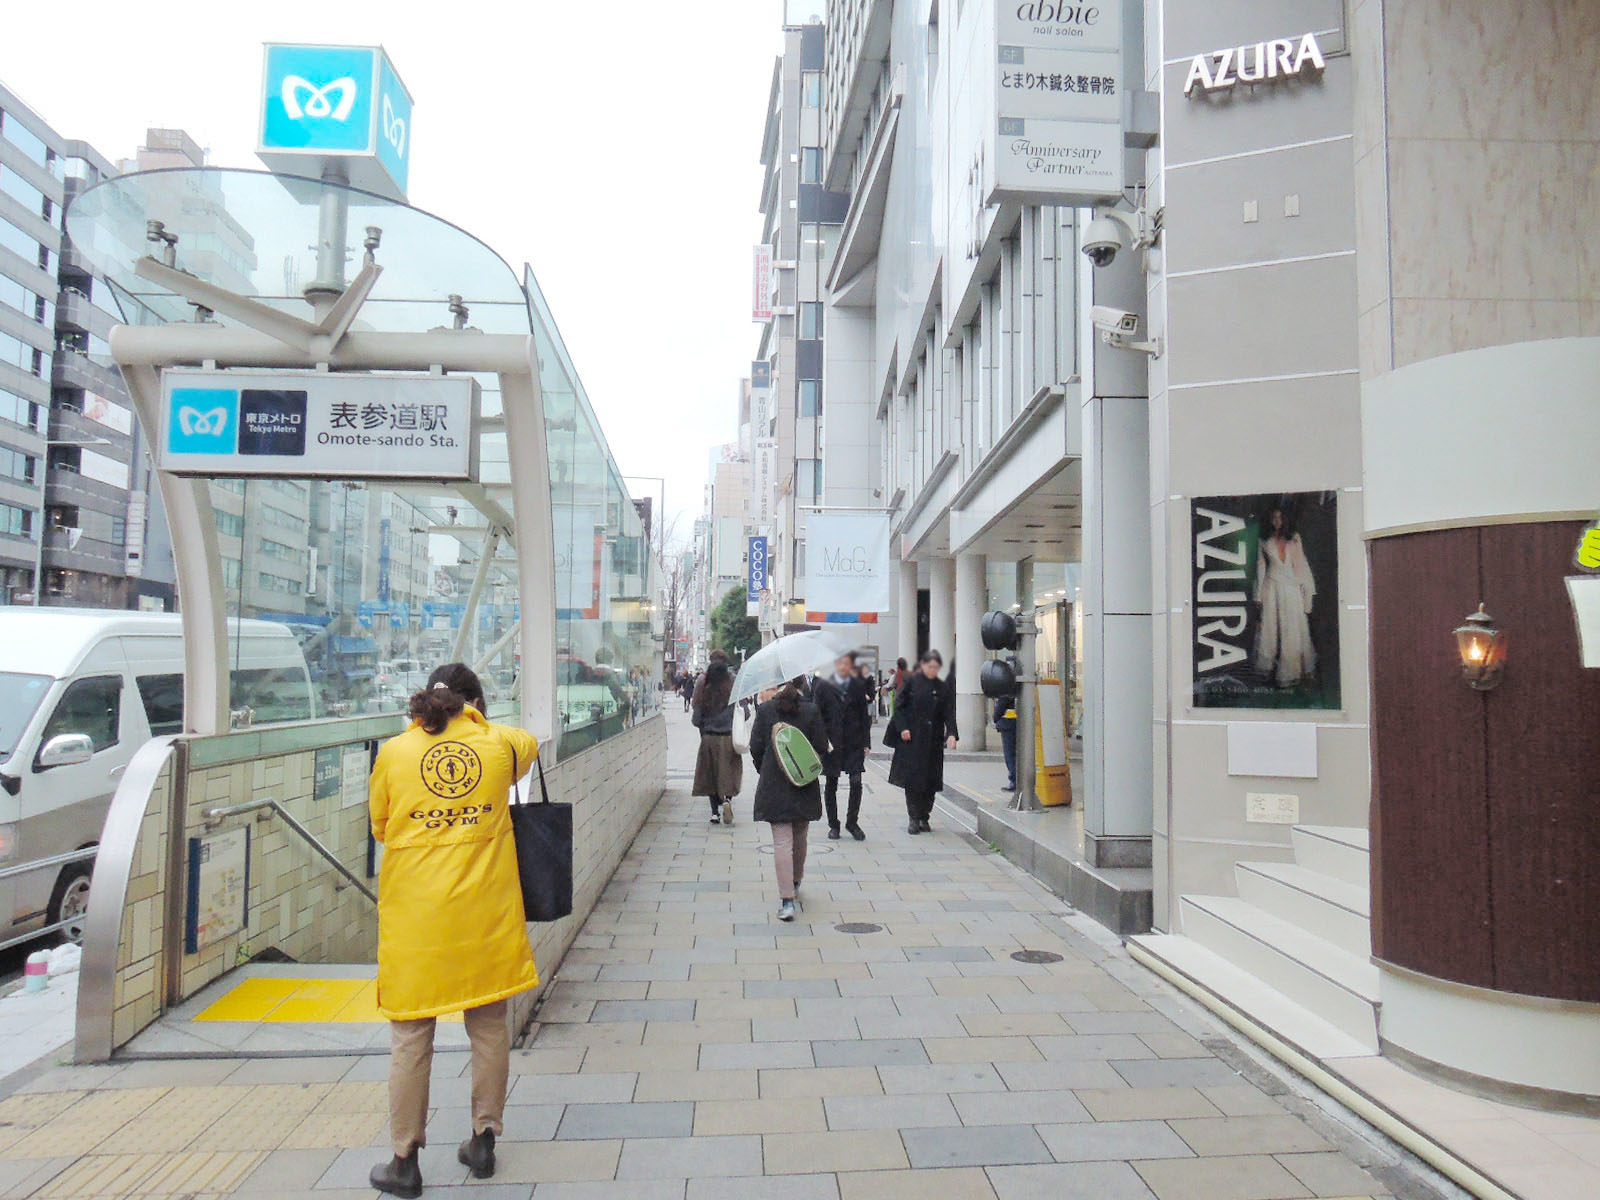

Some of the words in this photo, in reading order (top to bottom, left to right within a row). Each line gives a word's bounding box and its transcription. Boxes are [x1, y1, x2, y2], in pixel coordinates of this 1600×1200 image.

[1016, 0, 1100, 25] abbie
[1033, 26, 1053, 34] nail
[1055, 27, 1083, 37] salon
[1184, 32, 1326, 95] AZURA
[1001, 71, 1116, 95] とまり木鍼灸整骨院
[1011, 139, 1102, 164] Anniversary
[1026, 157, 1085, 174] Partner
[246, 412, 301, 424] 東京メトロ
[330, 402, 448, 431] 表参道駅
[249, 424, 272, 434] Tokyo
[273, 425, 297, 433] Metro
[317, 432, 425, 446] Omote-sando
[429, 434, 459, 448] Sta.
[1196, 507, 1249, 673] AZURA
[426, 745, 477, 772] GOLD'S
[433, 776, 475, 794] GYM
[409, 803, 493, 820] GOLD'S
[425, 816, 480, 829] GYM
